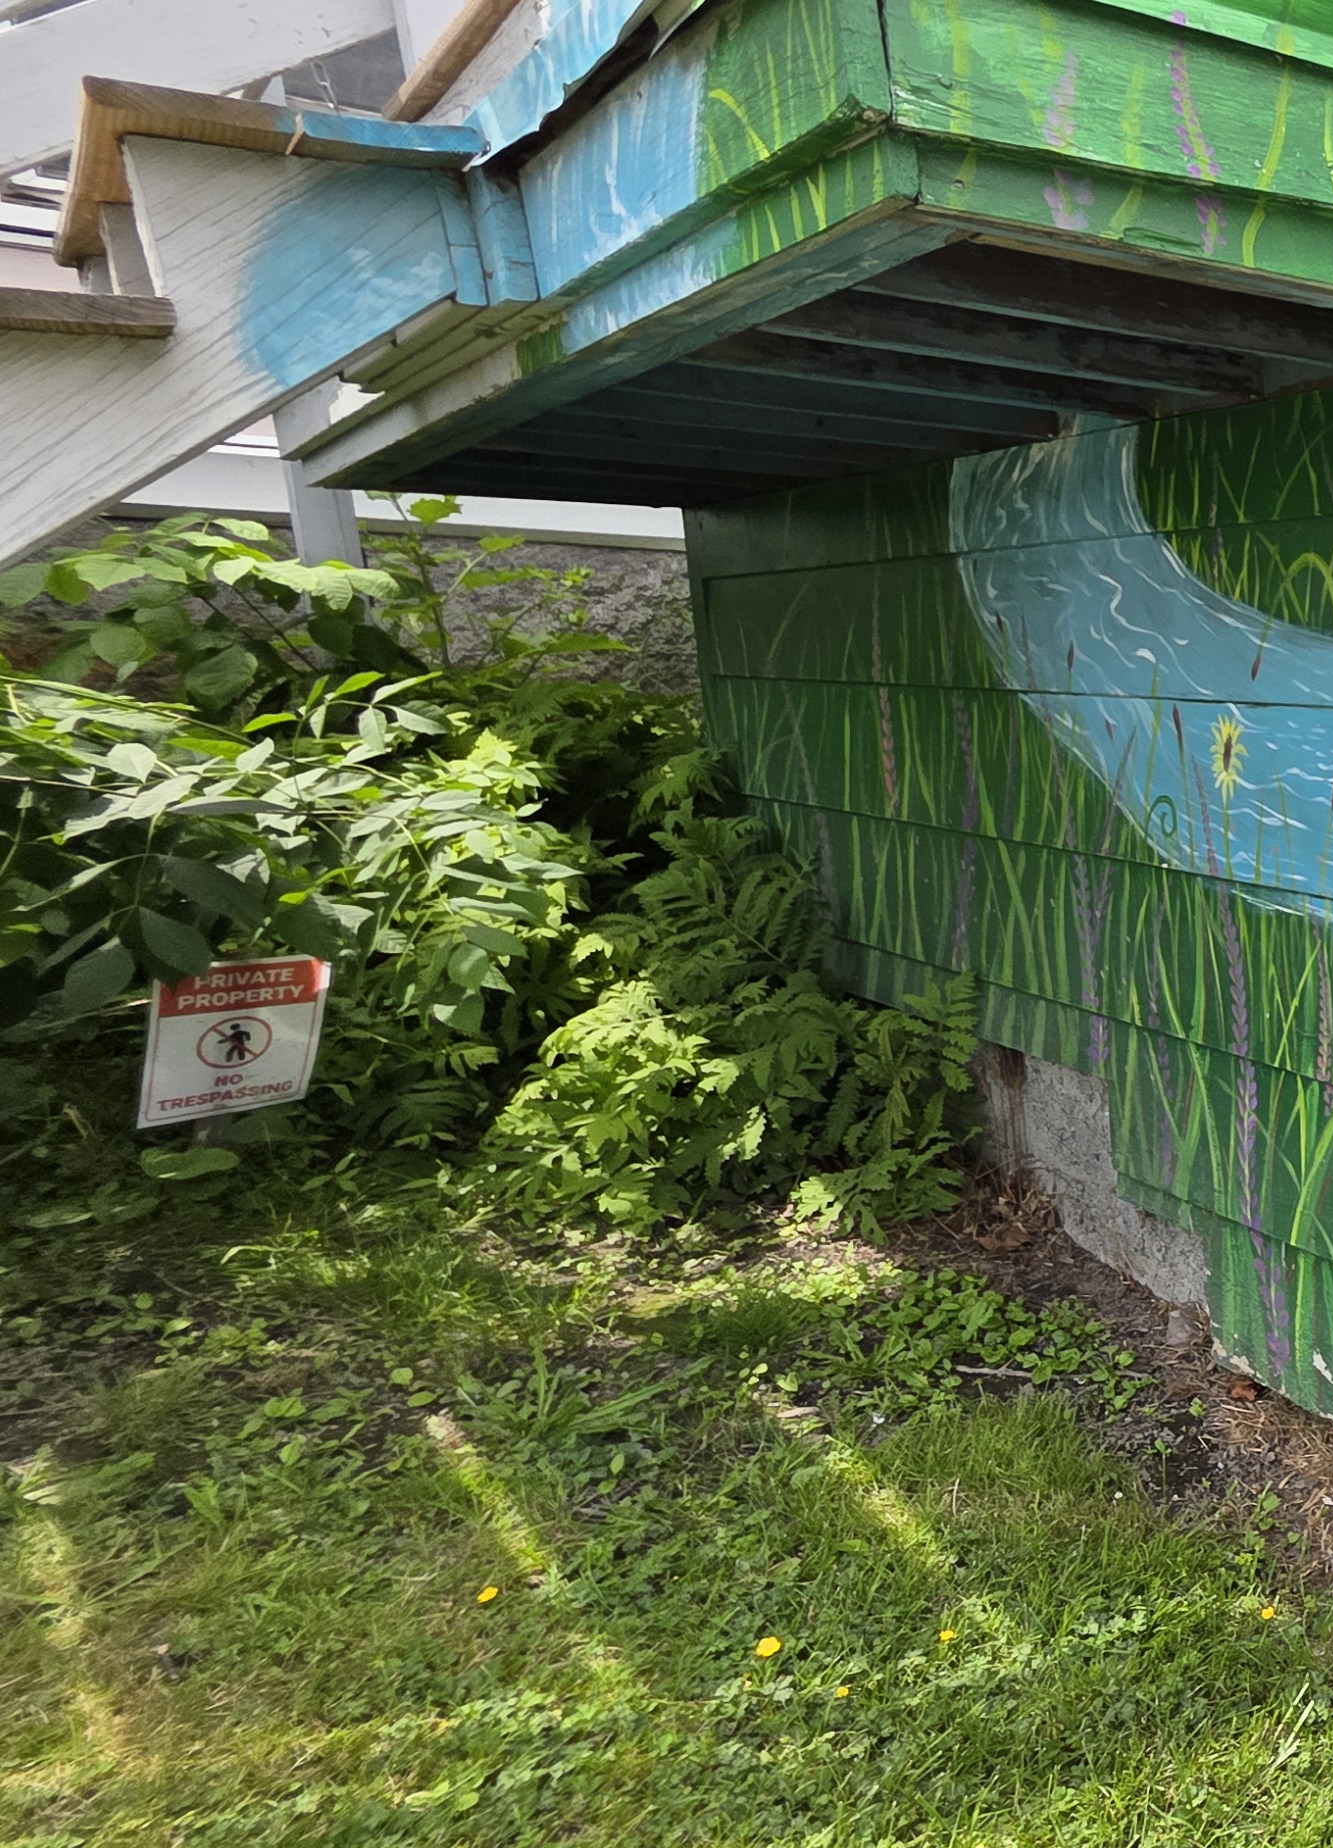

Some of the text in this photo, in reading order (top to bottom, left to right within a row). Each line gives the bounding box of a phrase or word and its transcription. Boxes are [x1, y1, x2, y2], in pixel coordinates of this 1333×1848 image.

[177, 984, 304, 1010] PROPERTY
[214, 1073, 244, 1088] NO
[157, 1080, 293, 1112] TRESPASSING
